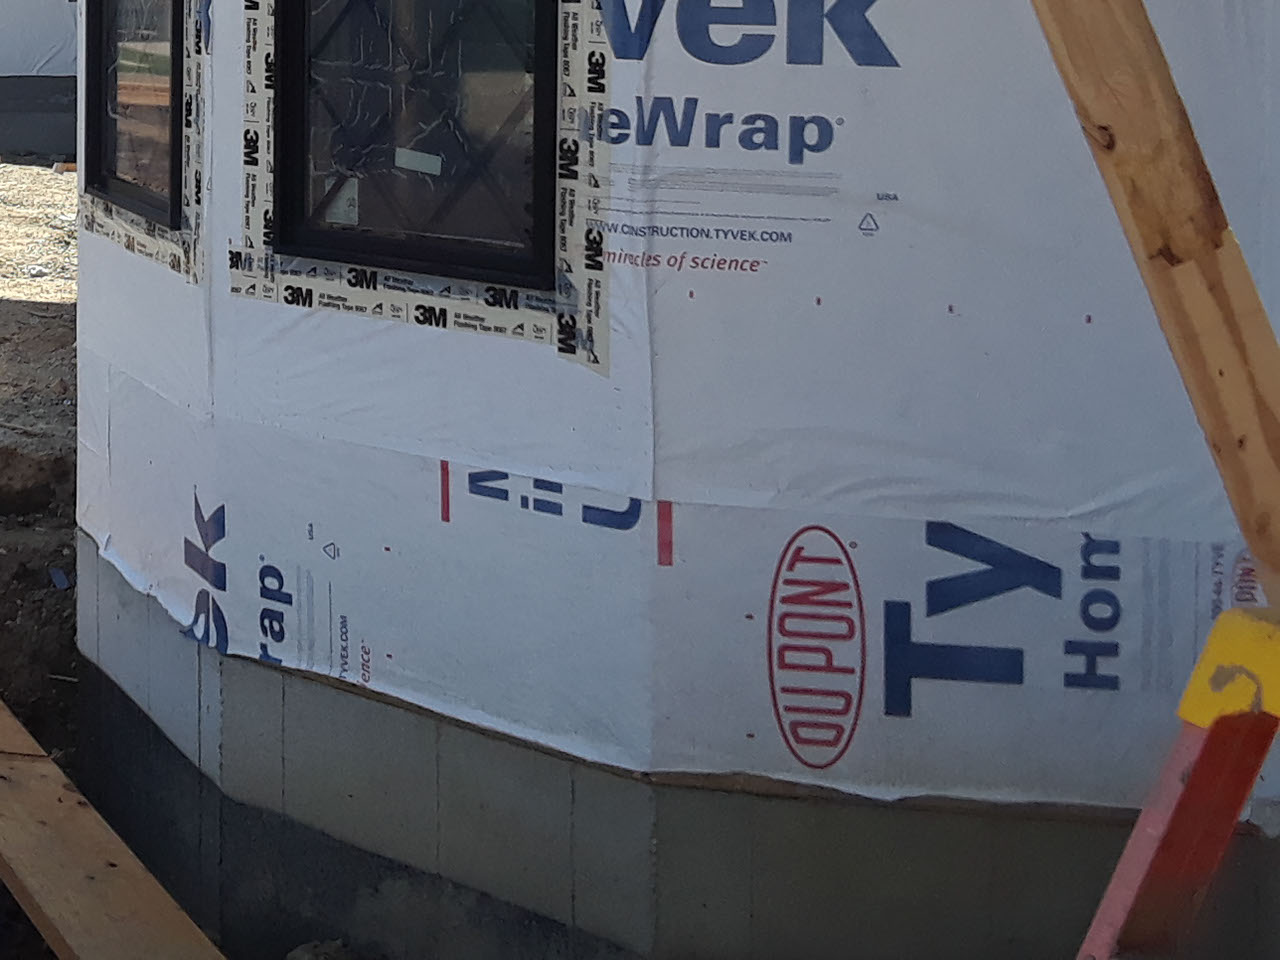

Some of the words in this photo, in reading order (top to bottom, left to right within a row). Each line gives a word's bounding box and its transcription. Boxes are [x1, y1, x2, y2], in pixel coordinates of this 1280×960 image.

[587, 50, 606, 94] 3M
[243, 129, 259, 166] 3M
[559, 138, 578, 180] 3M
[585, 228, 604, 271] 3M
[667, 251, 688, 272] of
[282, 286, 314, 309] 3M
[346, 267, 378, 290] 3M
[483, 285, 519, 311] 3M
[414, 304, 447, 329] 3M
[557, 313, 577, 355] 3M
[884, 521, 1062, 717] Ty
[777, 546, 856, 749] DUPONT
